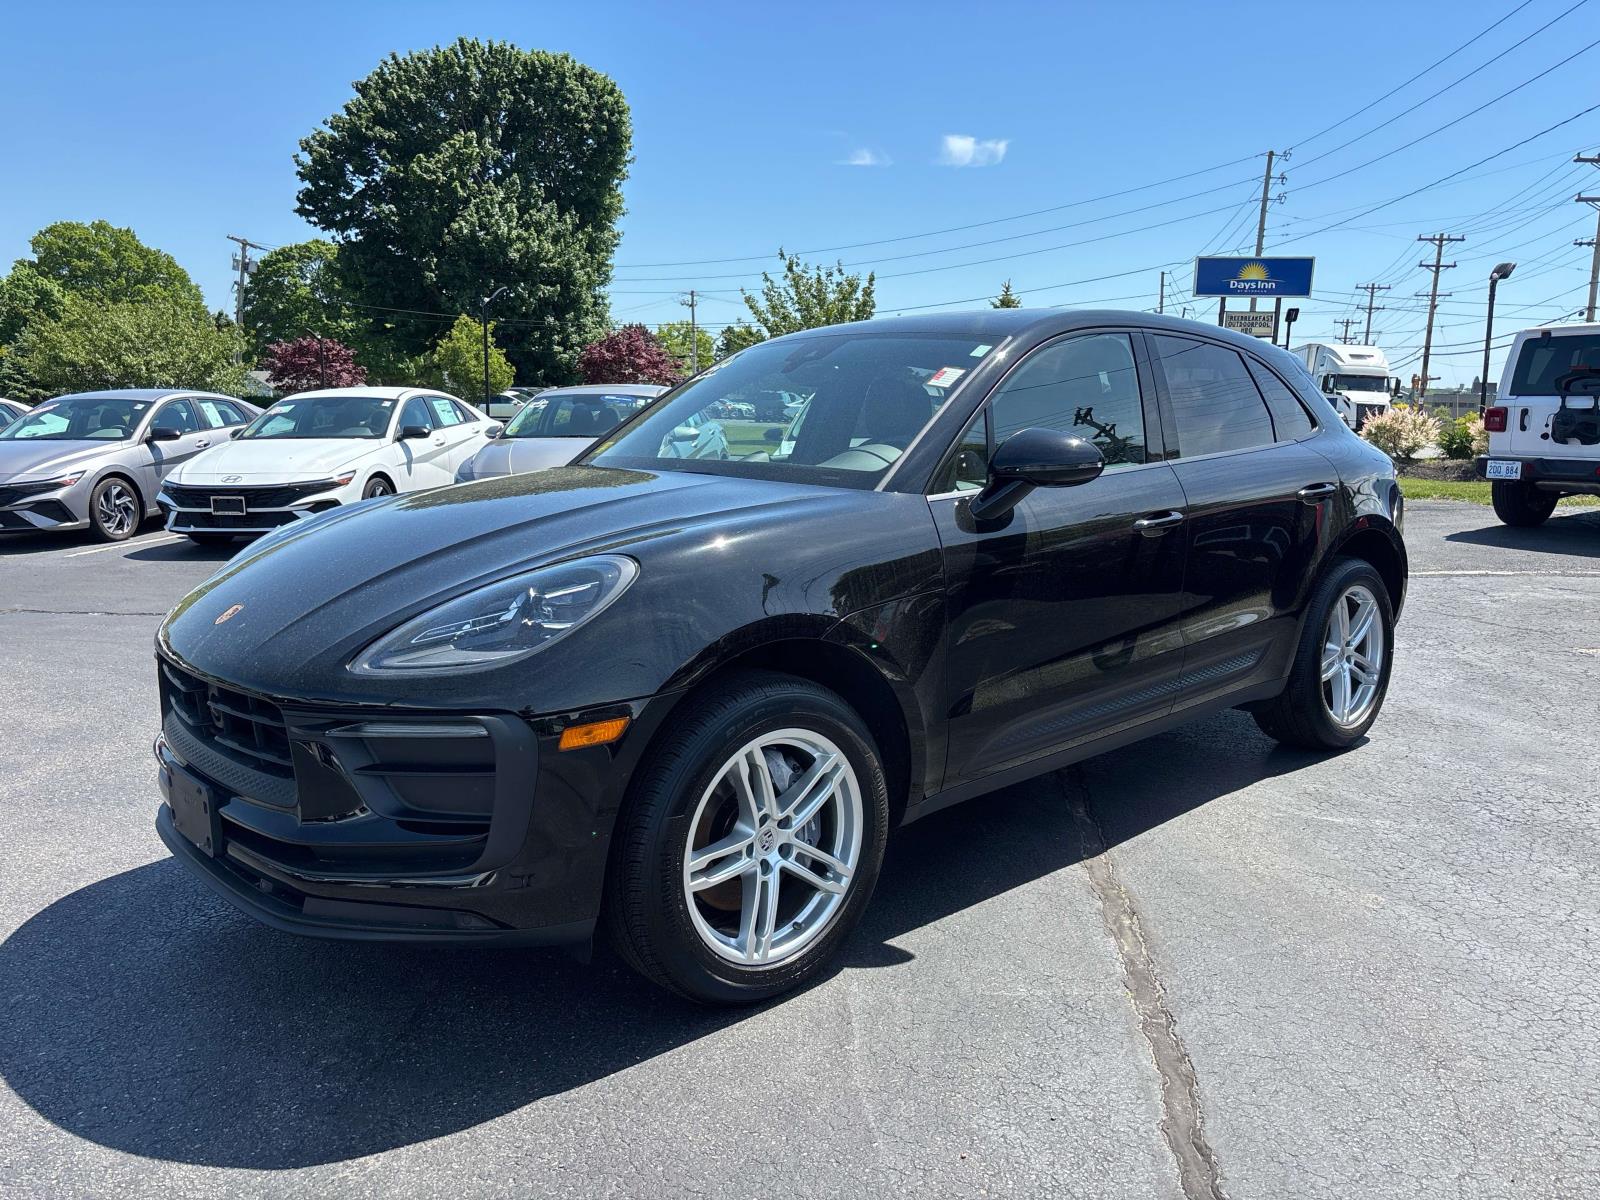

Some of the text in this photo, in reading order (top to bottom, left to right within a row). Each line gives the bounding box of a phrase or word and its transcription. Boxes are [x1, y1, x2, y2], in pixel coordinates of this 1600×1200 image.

[1230, 281, 1276, 289] Days Inn
[1505, 466, 1519, 475] 884
